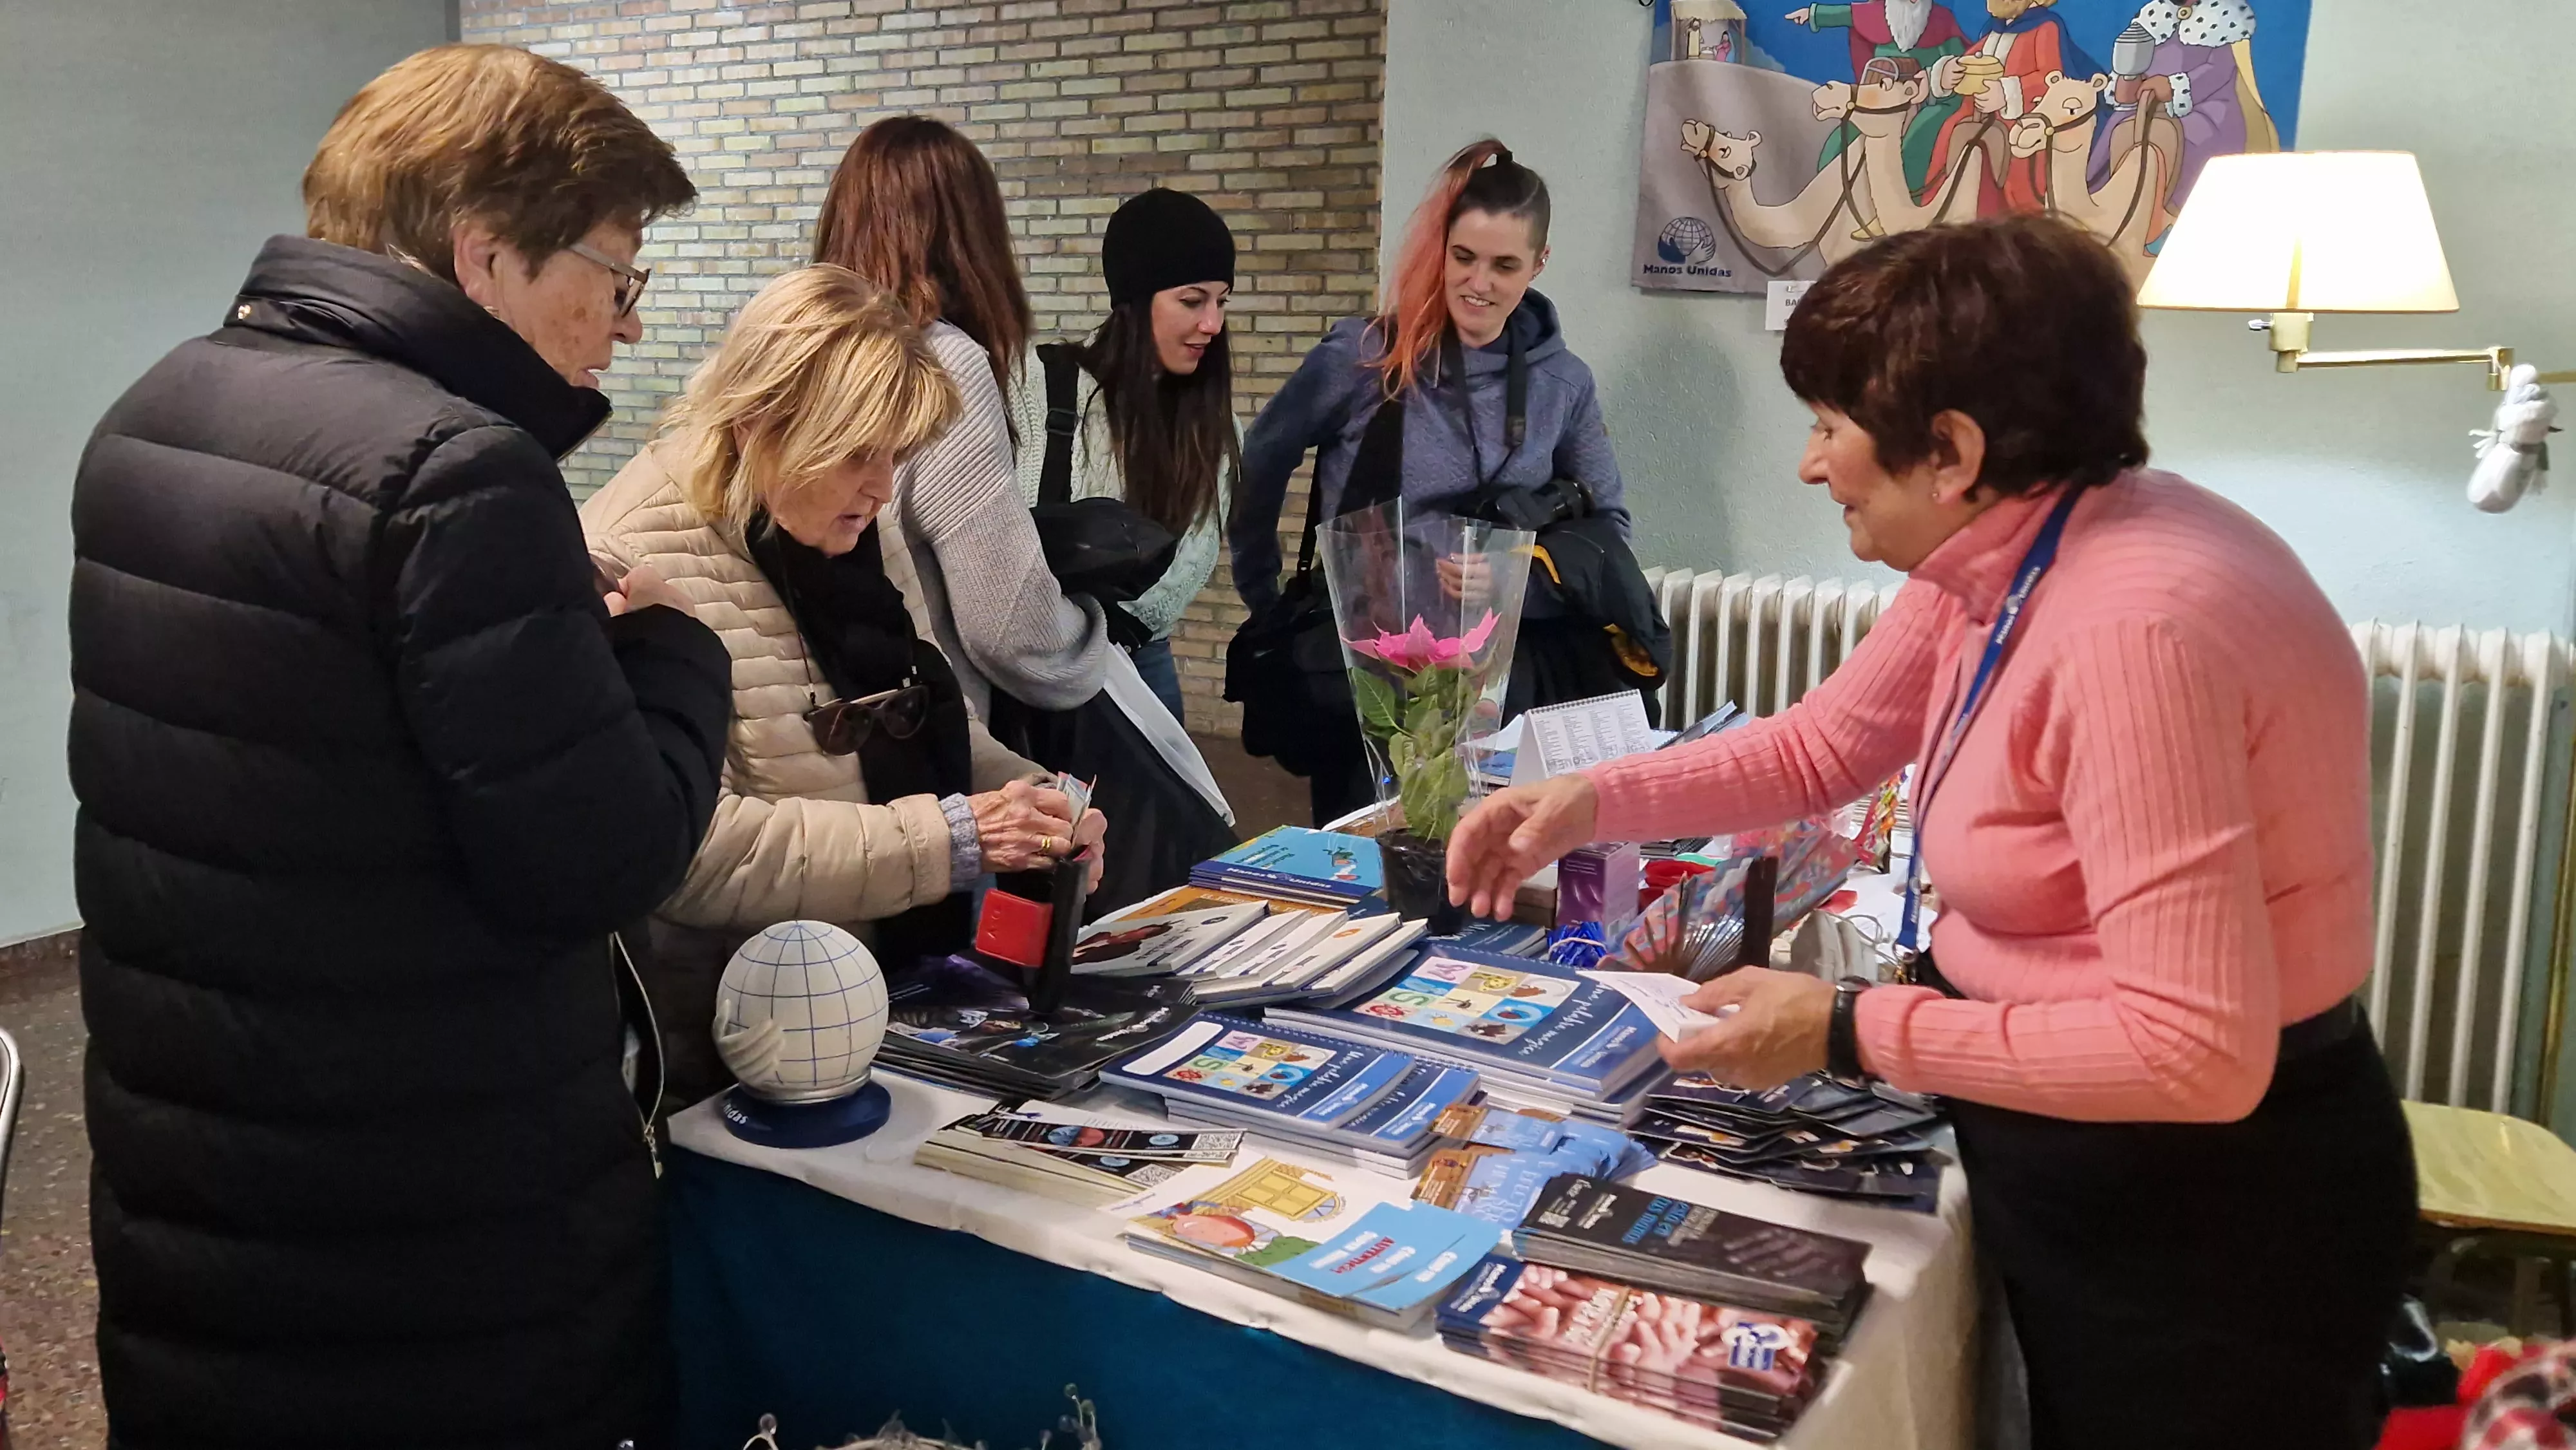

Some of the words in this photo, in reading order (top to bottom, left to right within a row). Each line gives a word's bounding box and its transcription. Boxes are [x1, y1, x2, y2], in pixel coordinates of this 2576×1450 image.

[1643, 263, 1682, 275] Manos
[1687, 265, 1732, 278] Unidas
[1226, 867, 1268, 879] Manos
[1289, 876, 1332, 889] Unidas
[723, 1100, 748, 1125] nidas
